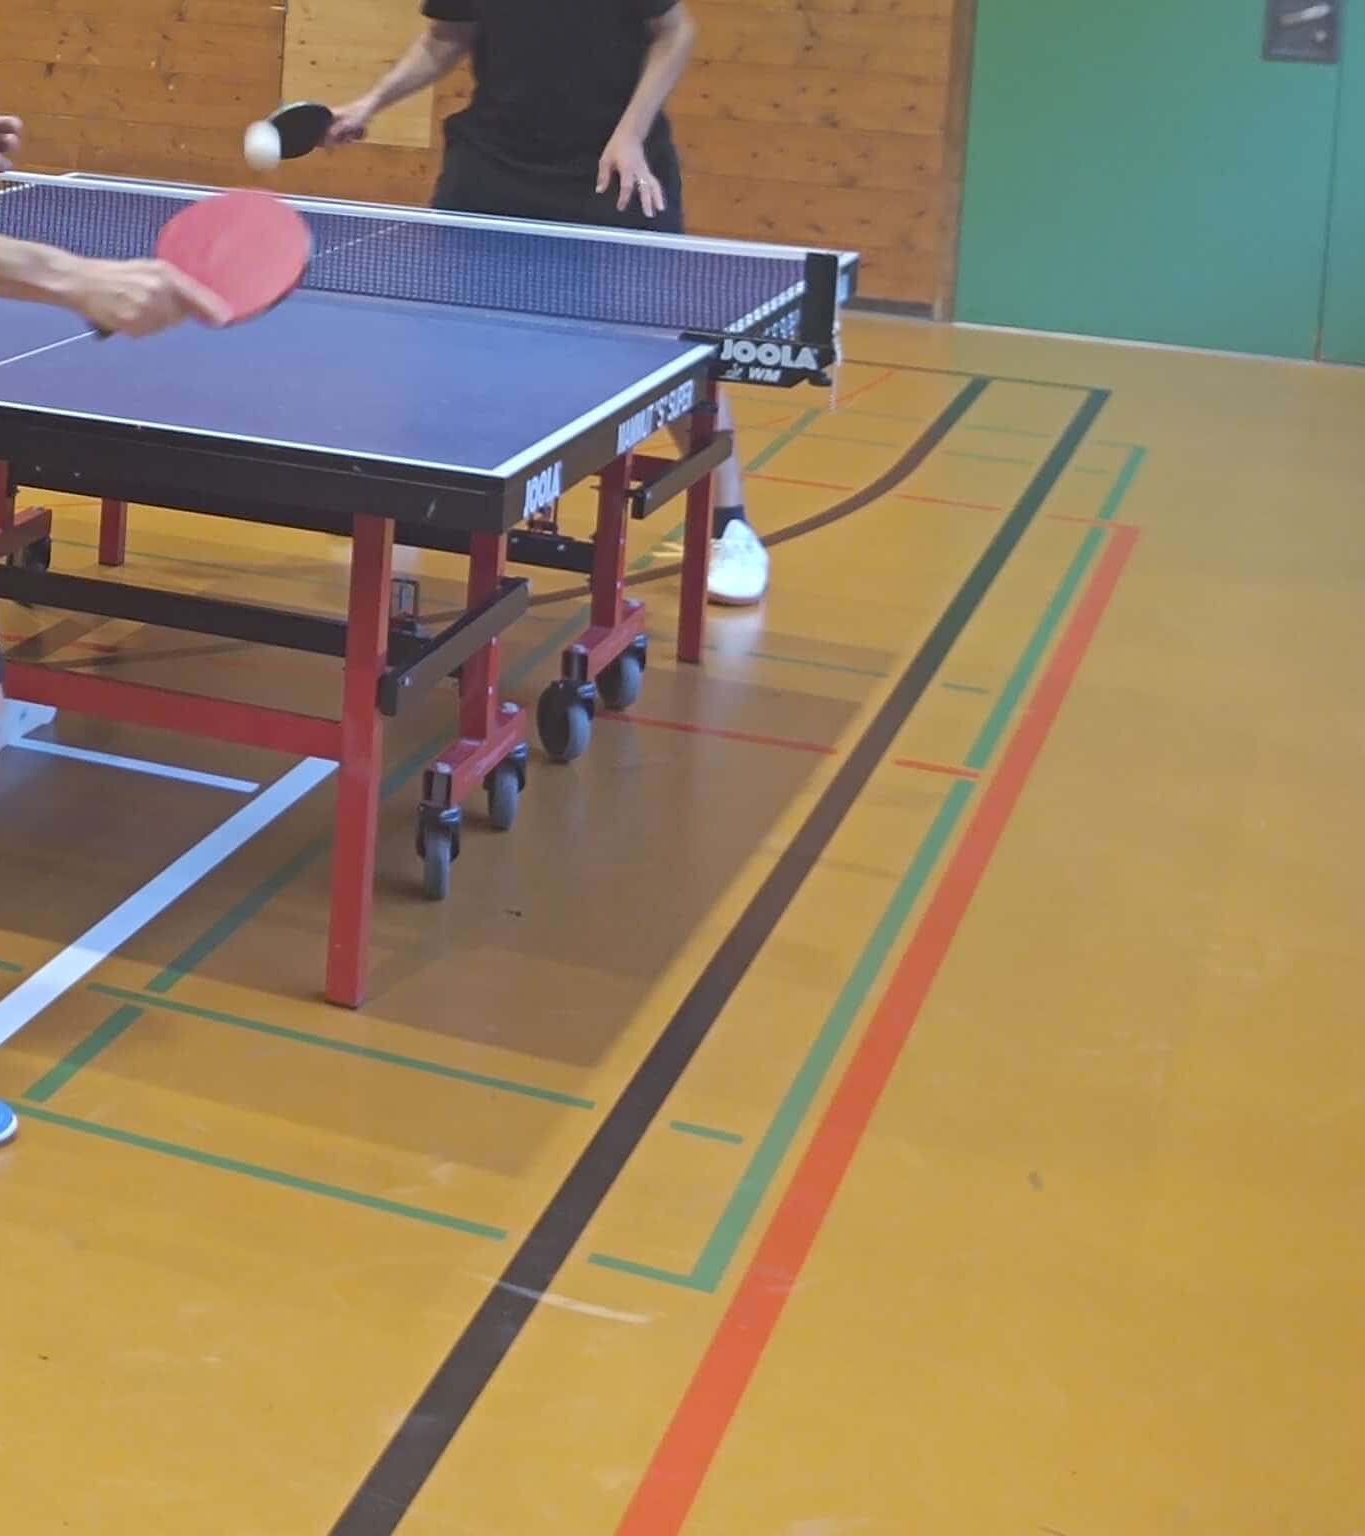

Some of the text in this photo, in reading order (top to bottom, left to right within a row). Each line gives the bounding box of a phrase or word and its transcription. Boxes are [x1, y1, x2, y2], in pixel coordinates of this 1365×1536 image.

[720, 339, 819, 370] JOOLA
[748, 367, 782, 382] WM
[523, 461, 561, 519] JOOLA
